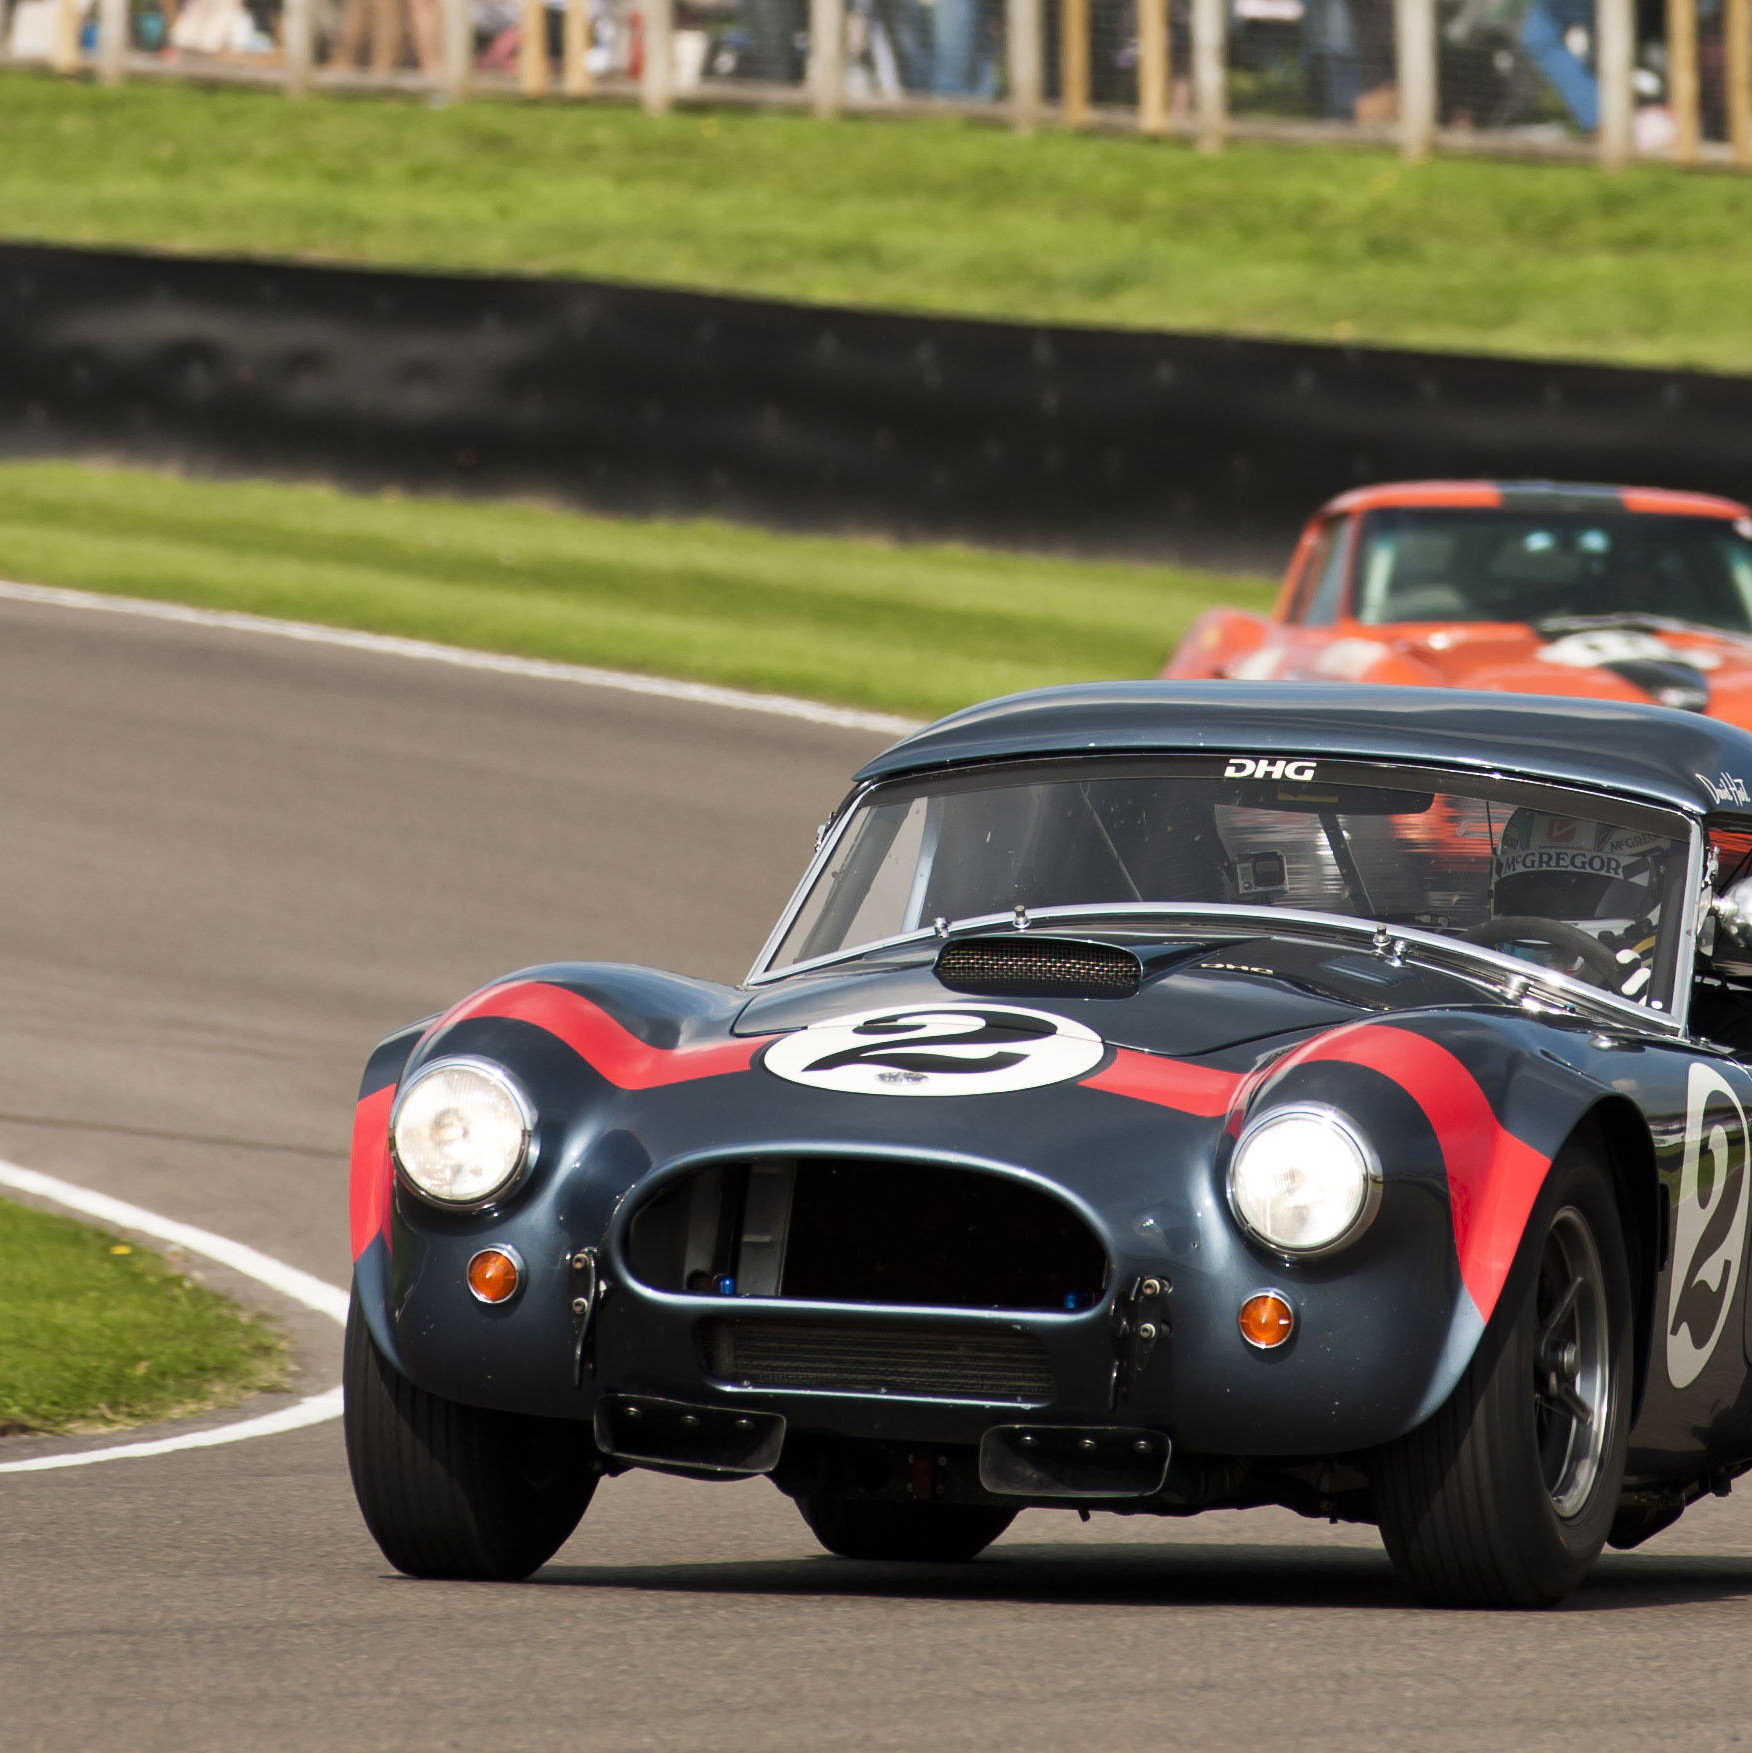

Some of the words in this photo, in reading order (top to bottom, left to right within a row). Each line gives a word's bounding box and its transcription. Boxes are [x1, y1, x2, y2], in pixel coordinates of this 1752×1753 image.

[1224, 758, 1317, 781] DHG
[1503, 851, 1622, 876] McGREGOR
[801, 1008, 1059, 1074] 2
[1669, 1089, 1733, 1351] 2
